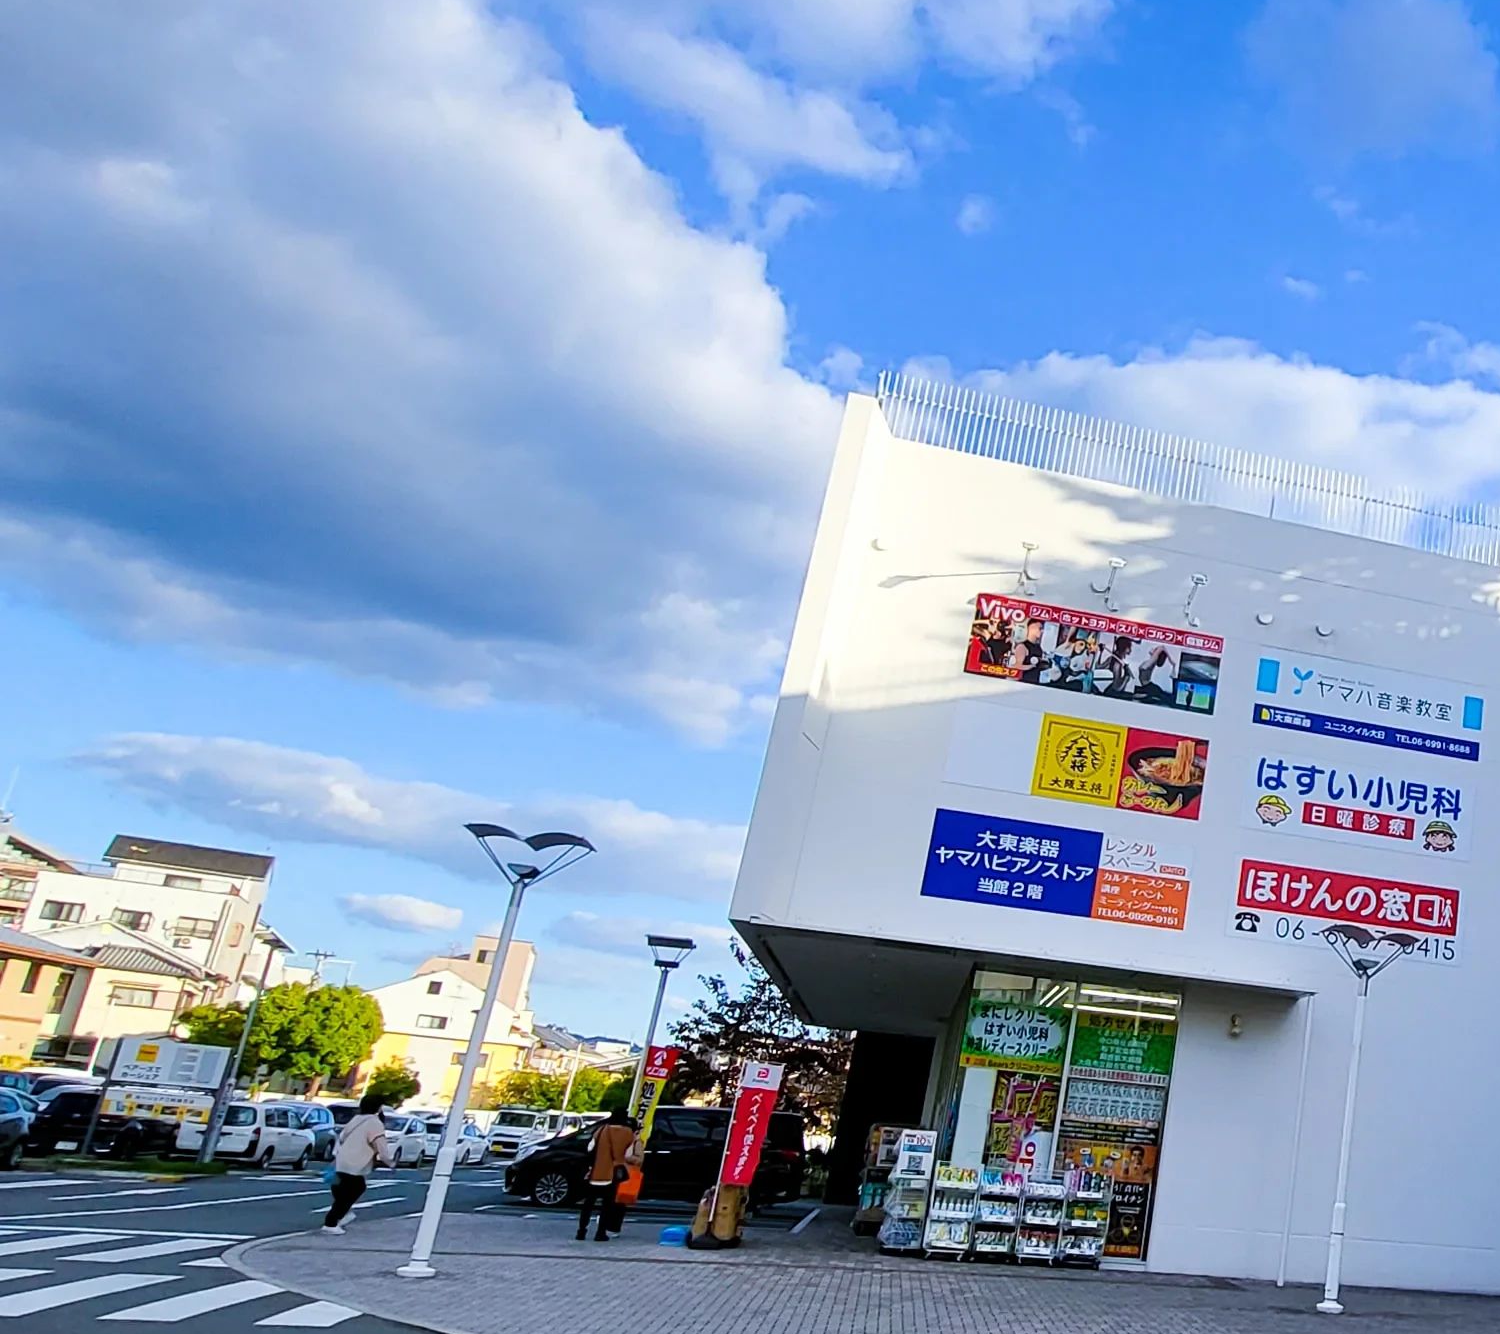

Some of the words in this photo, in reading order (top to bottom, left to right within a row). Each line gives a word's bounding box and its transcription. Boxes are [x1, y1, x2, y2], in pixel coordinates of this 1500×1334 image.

[980, 597, 1026, 623] Vivo
[1316, 680, 1452, 722] ヤマハ音楽教室
[1048, 776, 1103, 795] 大阪王将
[1257, 757, 1462, 820] はすい小児科
[1311, 806, 1407, 836] 日曜診療
[976, 830, 1060, 858] 大東楽器
[1105, 838, 1156, 857] レンタル
[935, 846, 1093, 882] ヤマハピアノストア
[1104, 853, 1157, 873] スペース
[1103, 872, 1184, 891] カルチャースクール
[1130, 888, 1164, 900] イベント
[1245, 869, 1445, 927] ほけんの窓口
[984, 1021, 1049, 1042] はすい小児科
